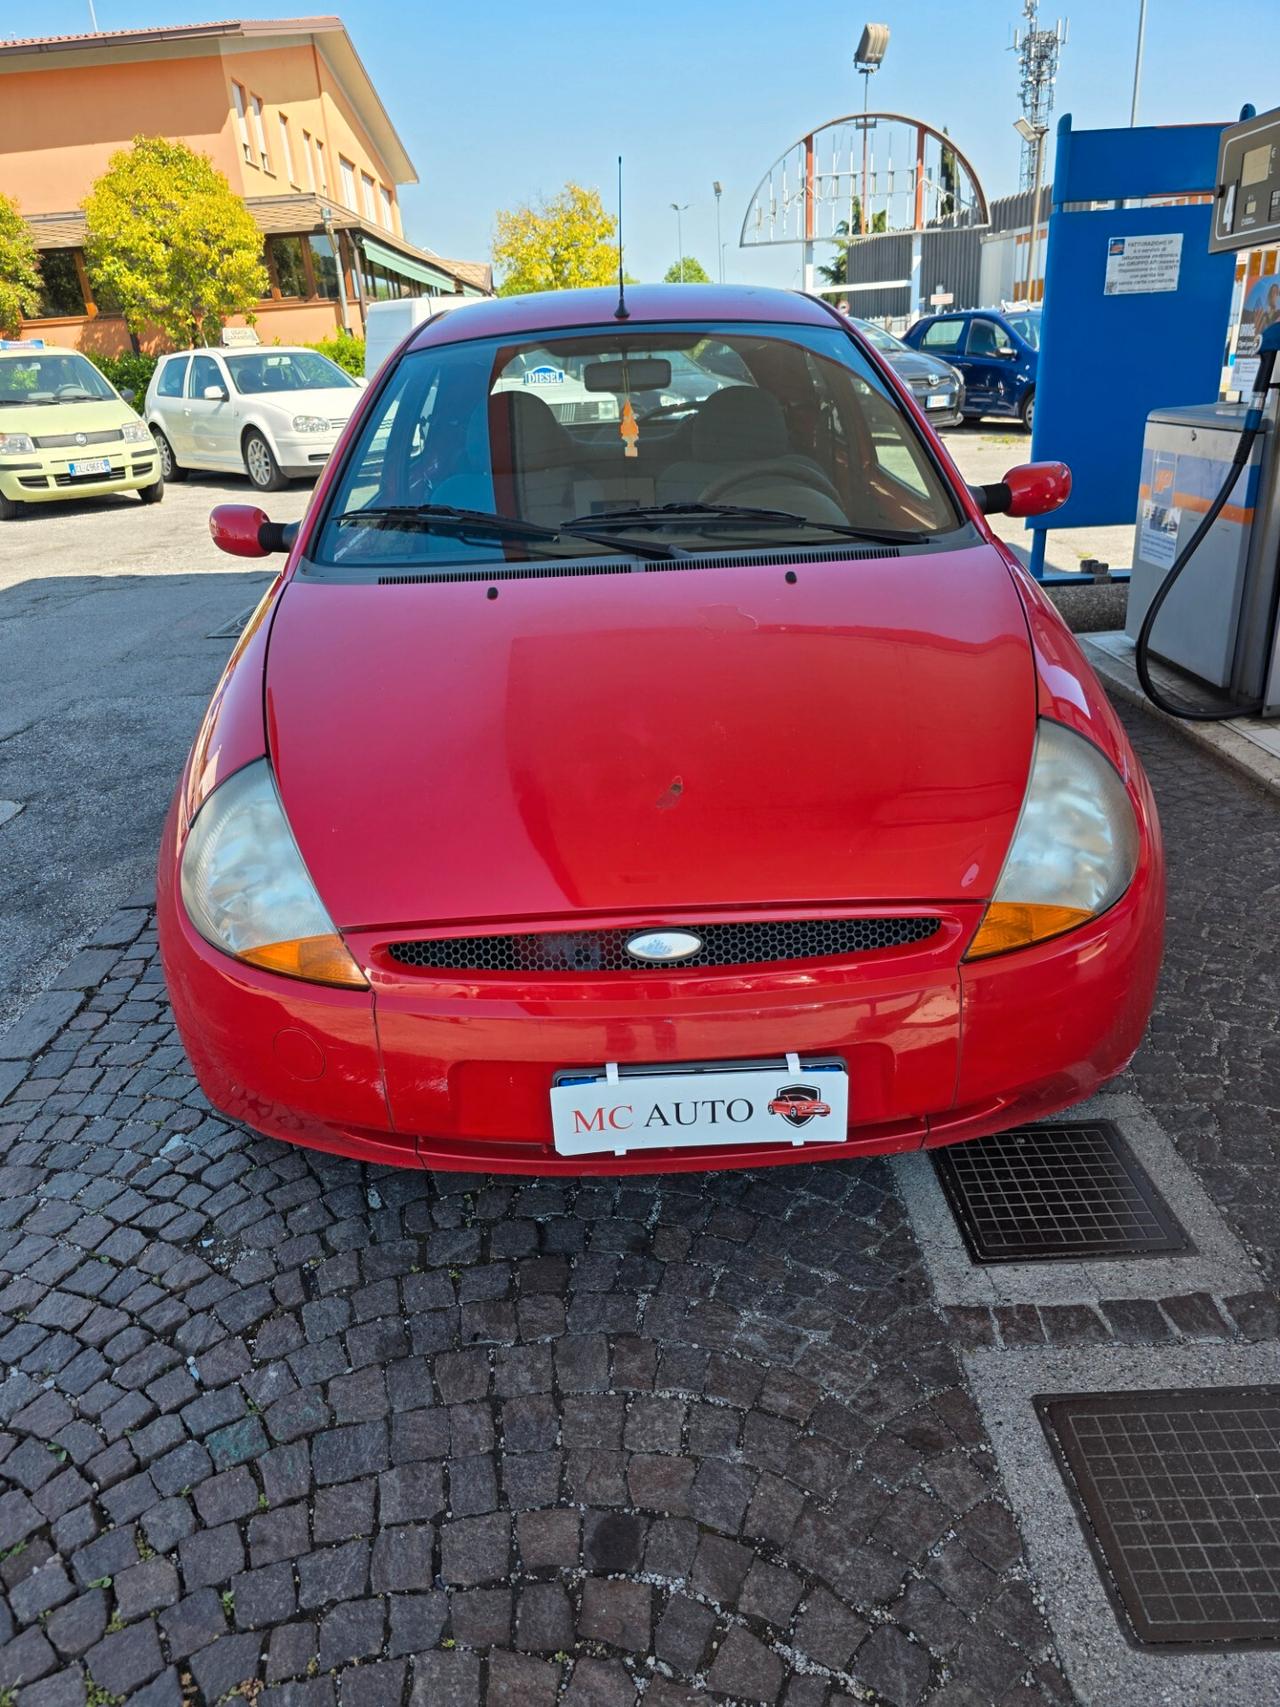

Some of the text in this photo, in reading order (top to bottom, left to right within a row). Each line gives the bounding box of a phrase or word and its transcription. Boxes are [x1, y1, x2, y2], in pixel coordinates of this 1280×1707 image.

[1223, 184, 1235, 232] 4
[528, 371, 564, 384] DIESEL
[572, 1098, 754, 1134] MC AUTO
